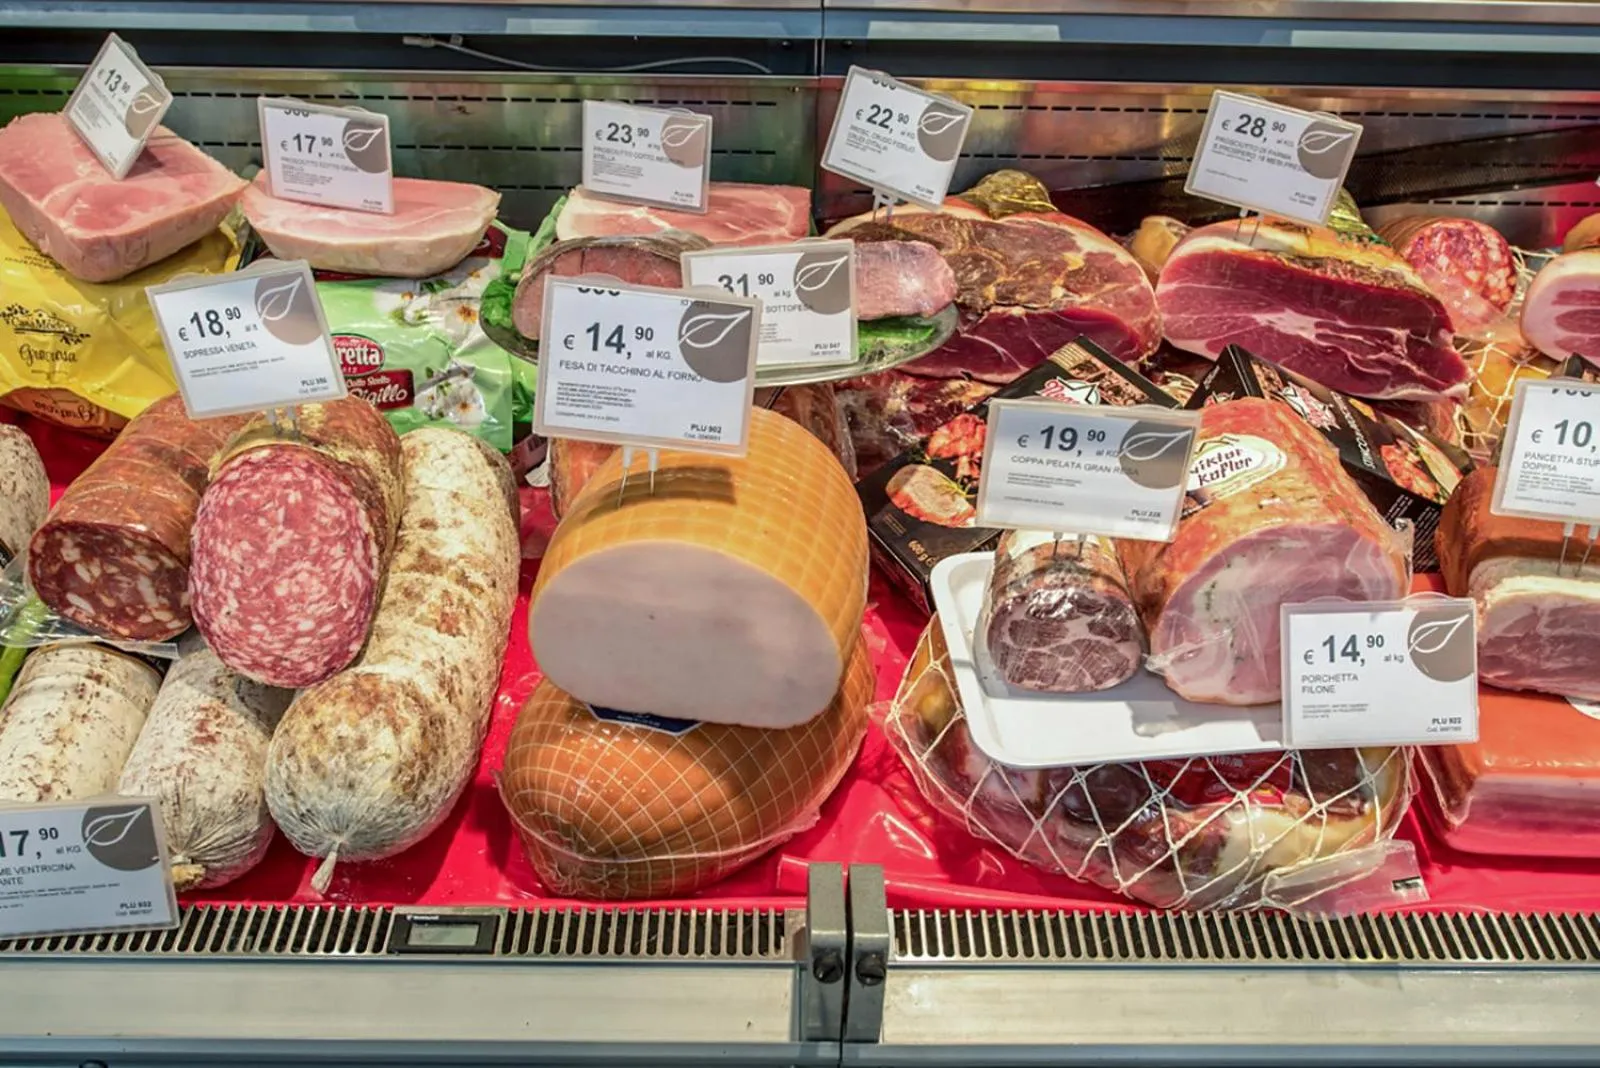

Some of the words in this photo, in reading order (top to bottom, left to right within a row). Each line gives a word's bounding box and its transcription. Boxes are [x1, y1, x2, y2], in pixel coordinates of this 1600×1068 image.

[183, 347, 226, 360] SOPRESSA
[226, 341, 258, 354] VENETA
[563, 334, 576, 350] €
[645, 349, 655, 359] al
[336, 344, 381, 366] retta
[559, 359, 586, 371] FESA
[586, 362, 598, 372] DI
[599, 363, 652, 378] TACCHINO
[652, 368, 666, 380] AL
[667, 370, 703, 383] FORNO
[1016, 433, 1030, 448] €
[1531, 429, 1544, 444] €
[1011, 454, 1044, 466] COPPA
[1046, 458, 1083, 471] PELATA
[1083, 462, 1112, 474] GRAN
[1523, 451, 1575, 465] PANCETTA
[1521, 460, 1558, 472] DOPPIA
[1303, 649, 1315, 665] €
[1392, 653, 1405, 664] kg
[1301, 672, 1359, 684] PORCHETTA
[1301, 684, 1336, 695] FILONE
[14, 863, 77, 876] VENTRICINA
